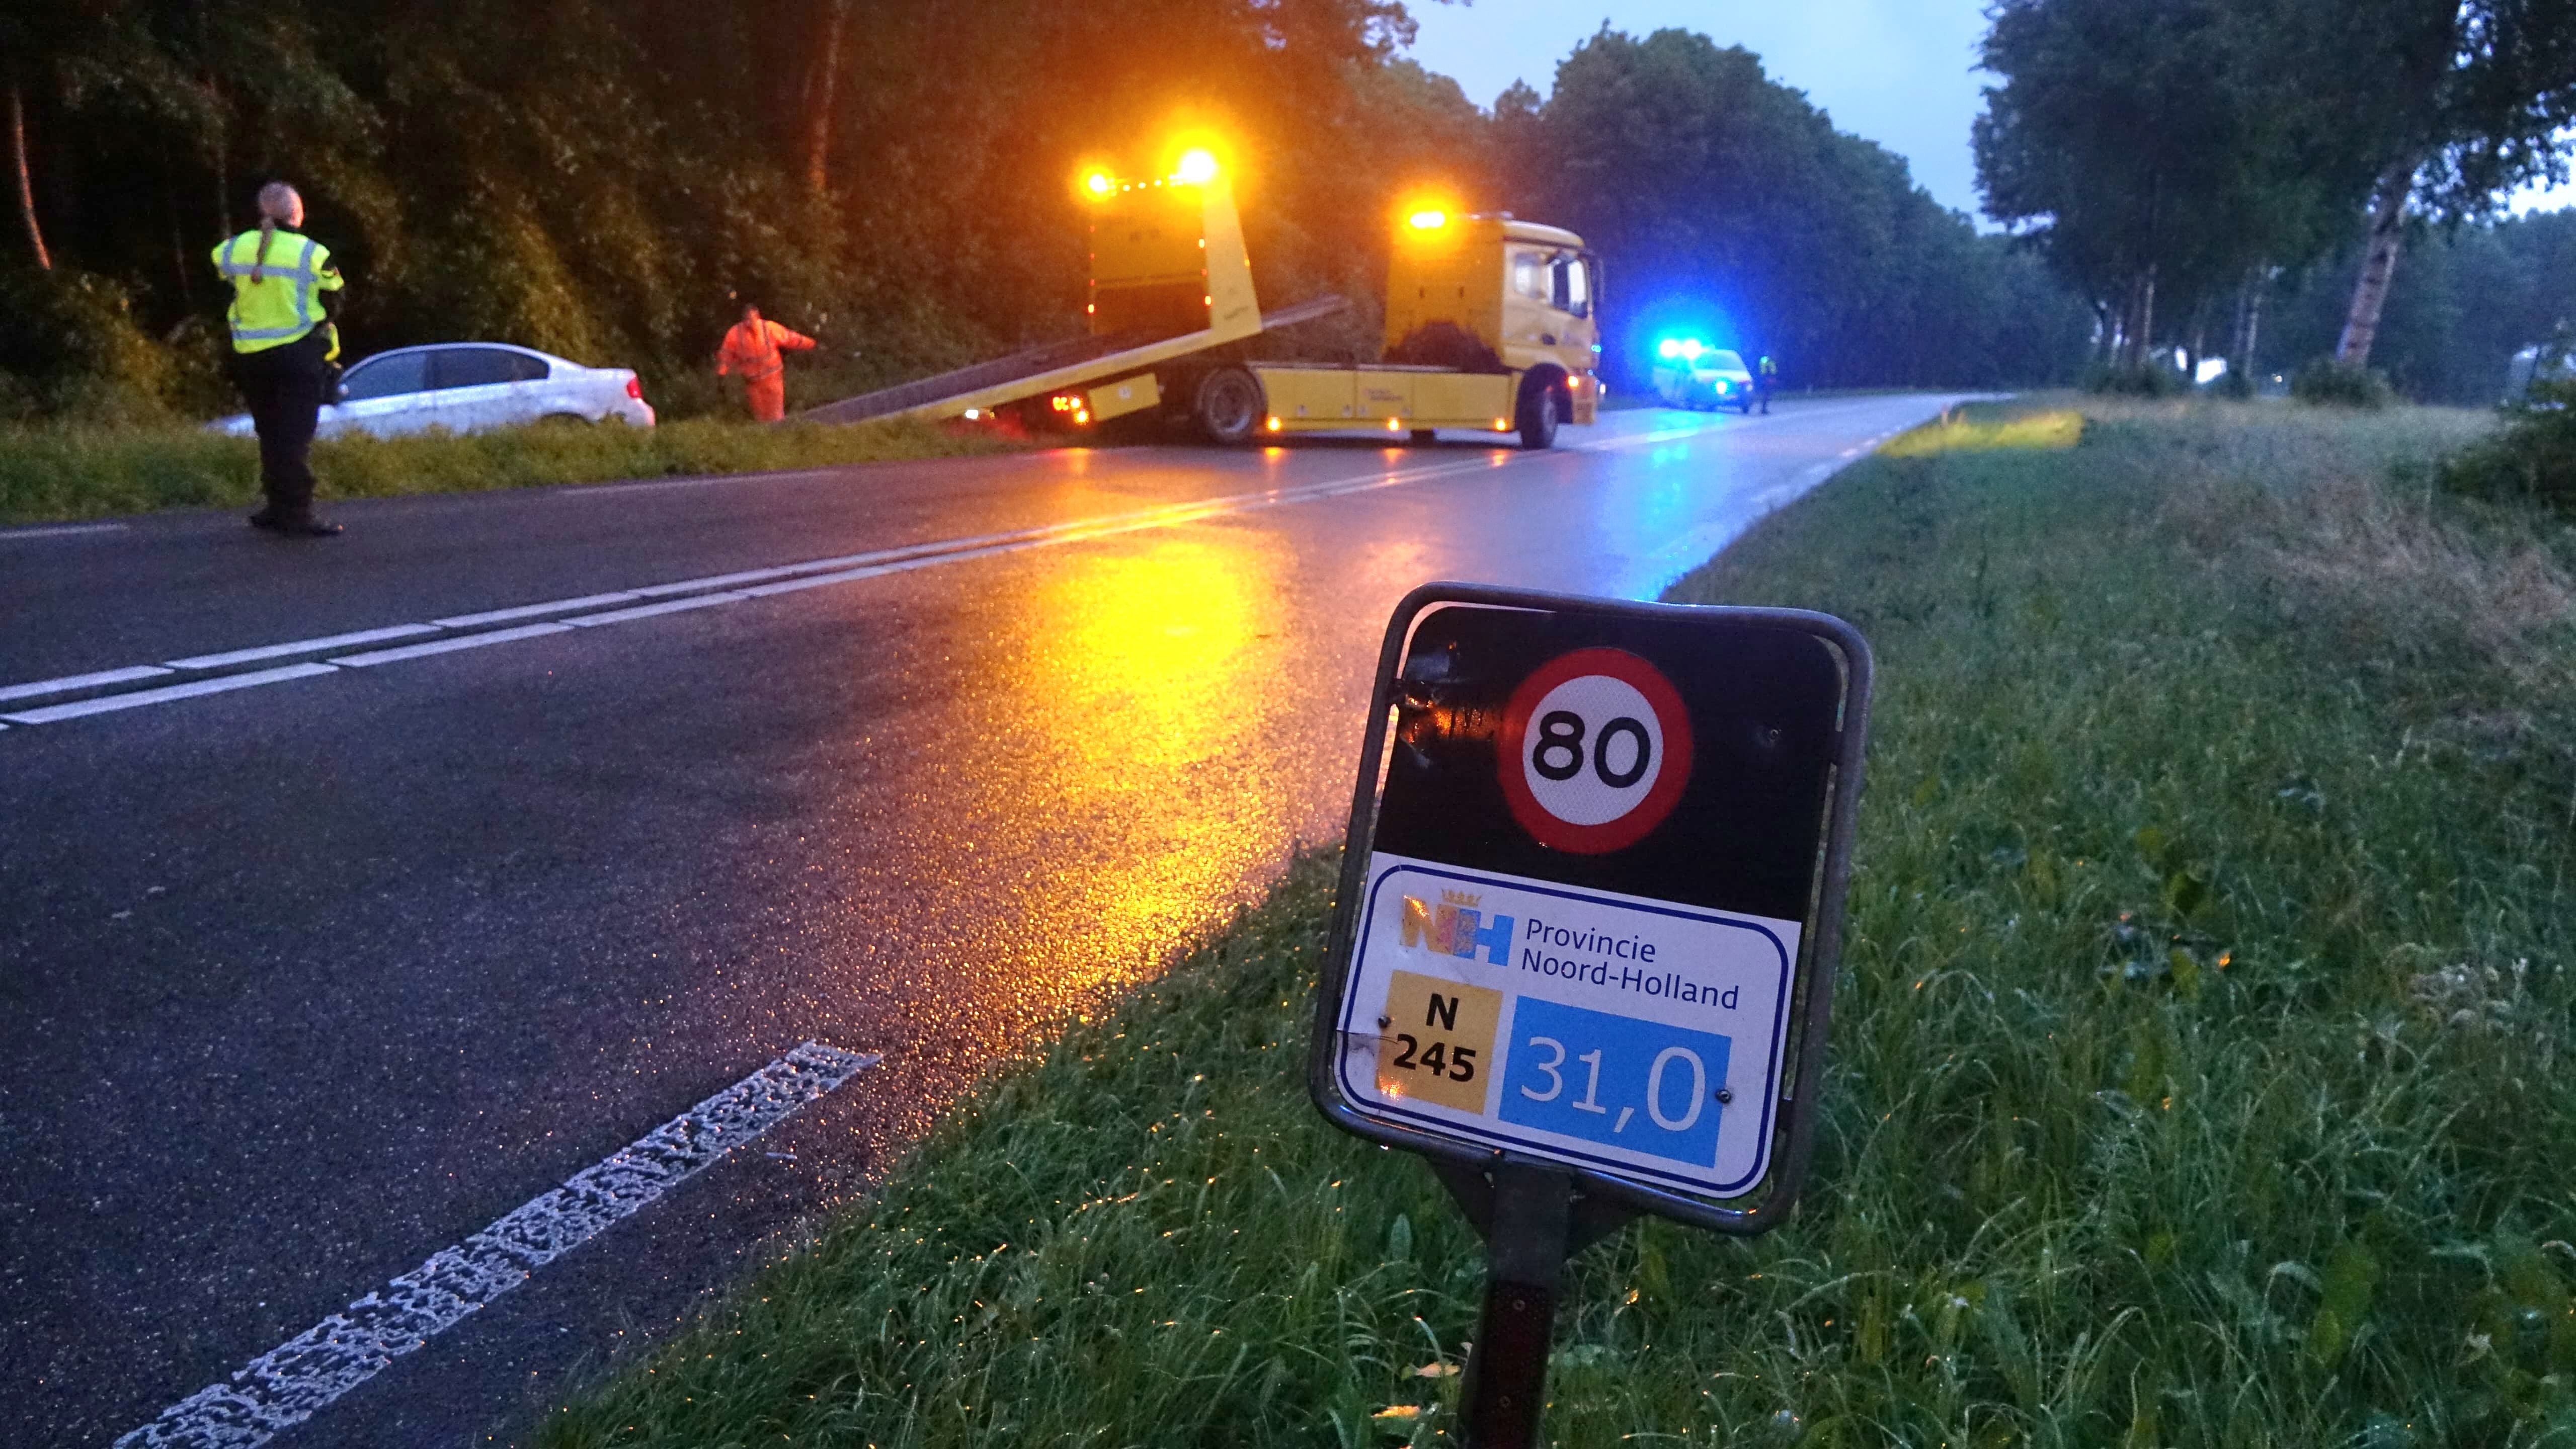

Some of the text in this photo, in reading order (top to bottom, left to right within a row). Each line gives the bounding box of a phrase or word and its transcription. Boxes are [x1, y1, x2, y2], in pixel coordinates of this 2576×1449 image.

[1532, 710, 1652, 788] 80
[1526, 918, 1656, 963] Provincie
[1521, 947, 1739, 1010] Noord-Holland
[1425, 993, 1459, 1030] N
[1393, 1033, 1478, 1083] 245
[1520, 1036, 1707, 1135] 31,0
